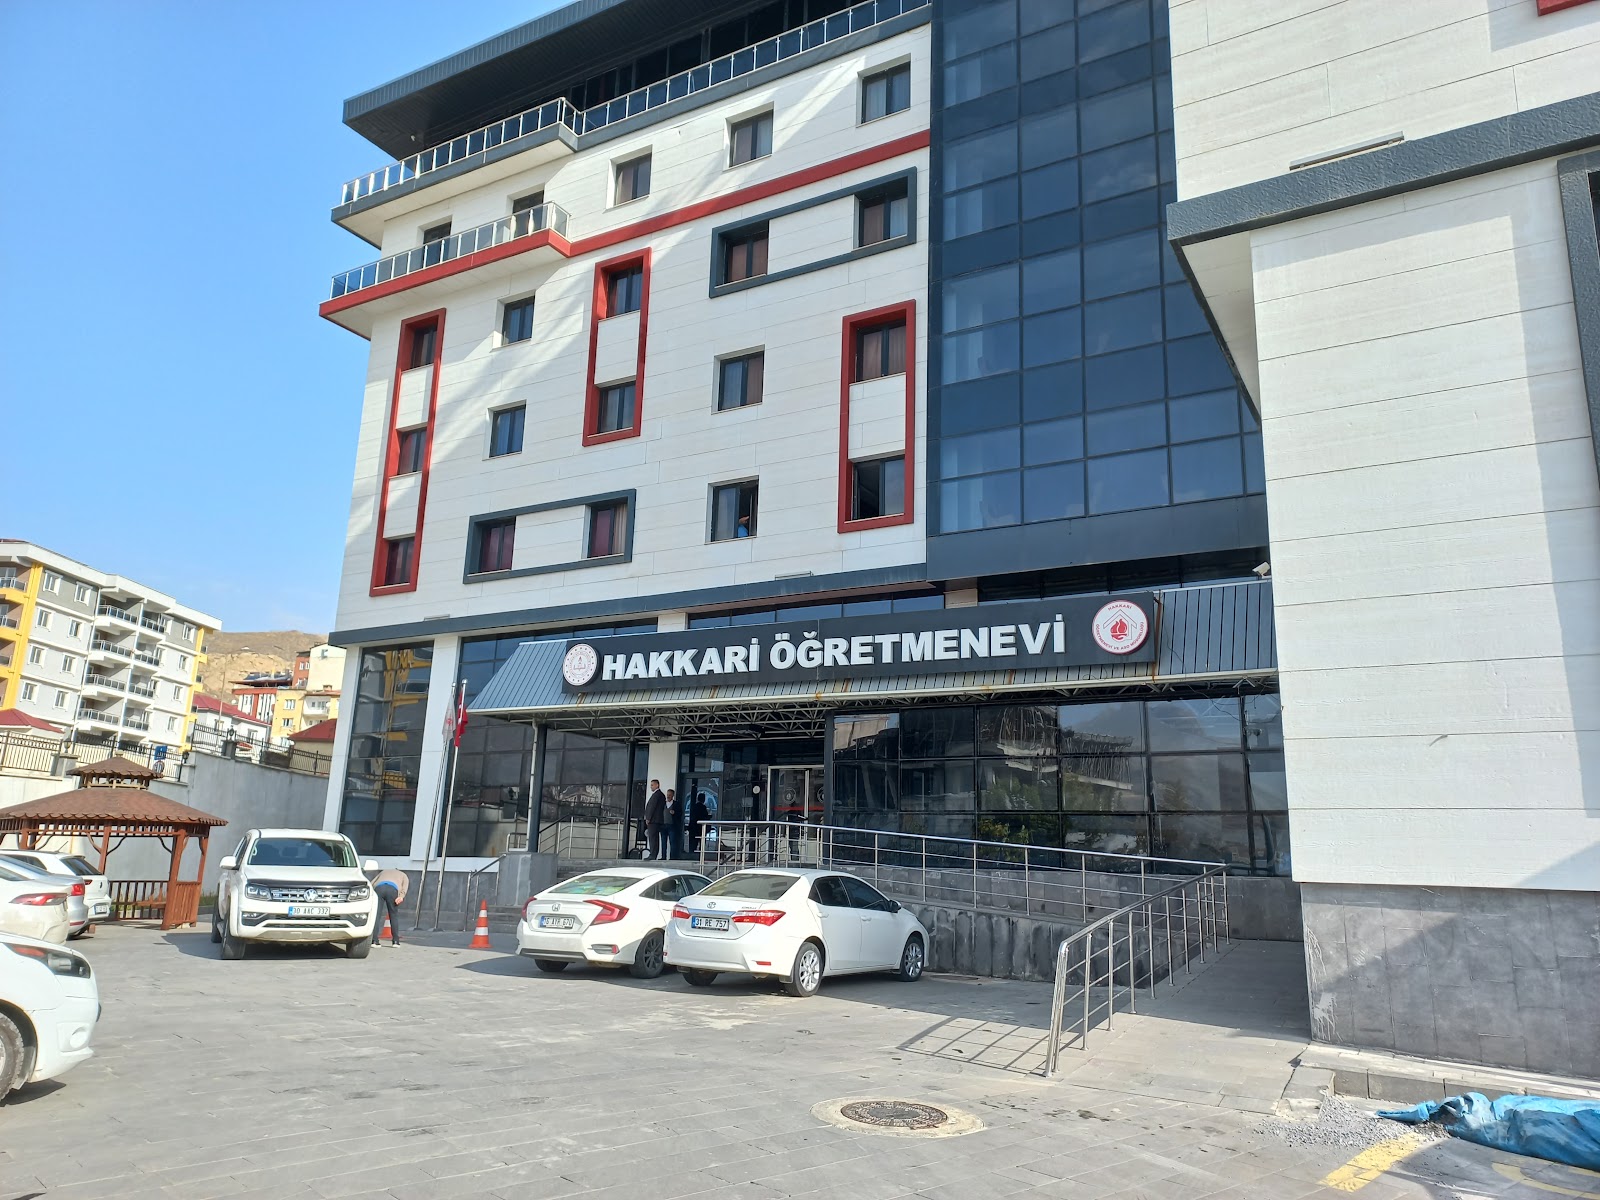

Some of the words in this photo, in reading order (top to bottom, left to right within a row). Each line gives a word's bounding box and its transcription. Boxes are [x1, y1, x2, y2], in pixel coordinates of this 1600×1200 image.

[602, 637, 760, 681] HAKKARİ
[769, 613, 1066, 670] ÖĞRETMENEVİ
[695, 917, 702, 926] 31
[715, 919, 727, 928] 757
